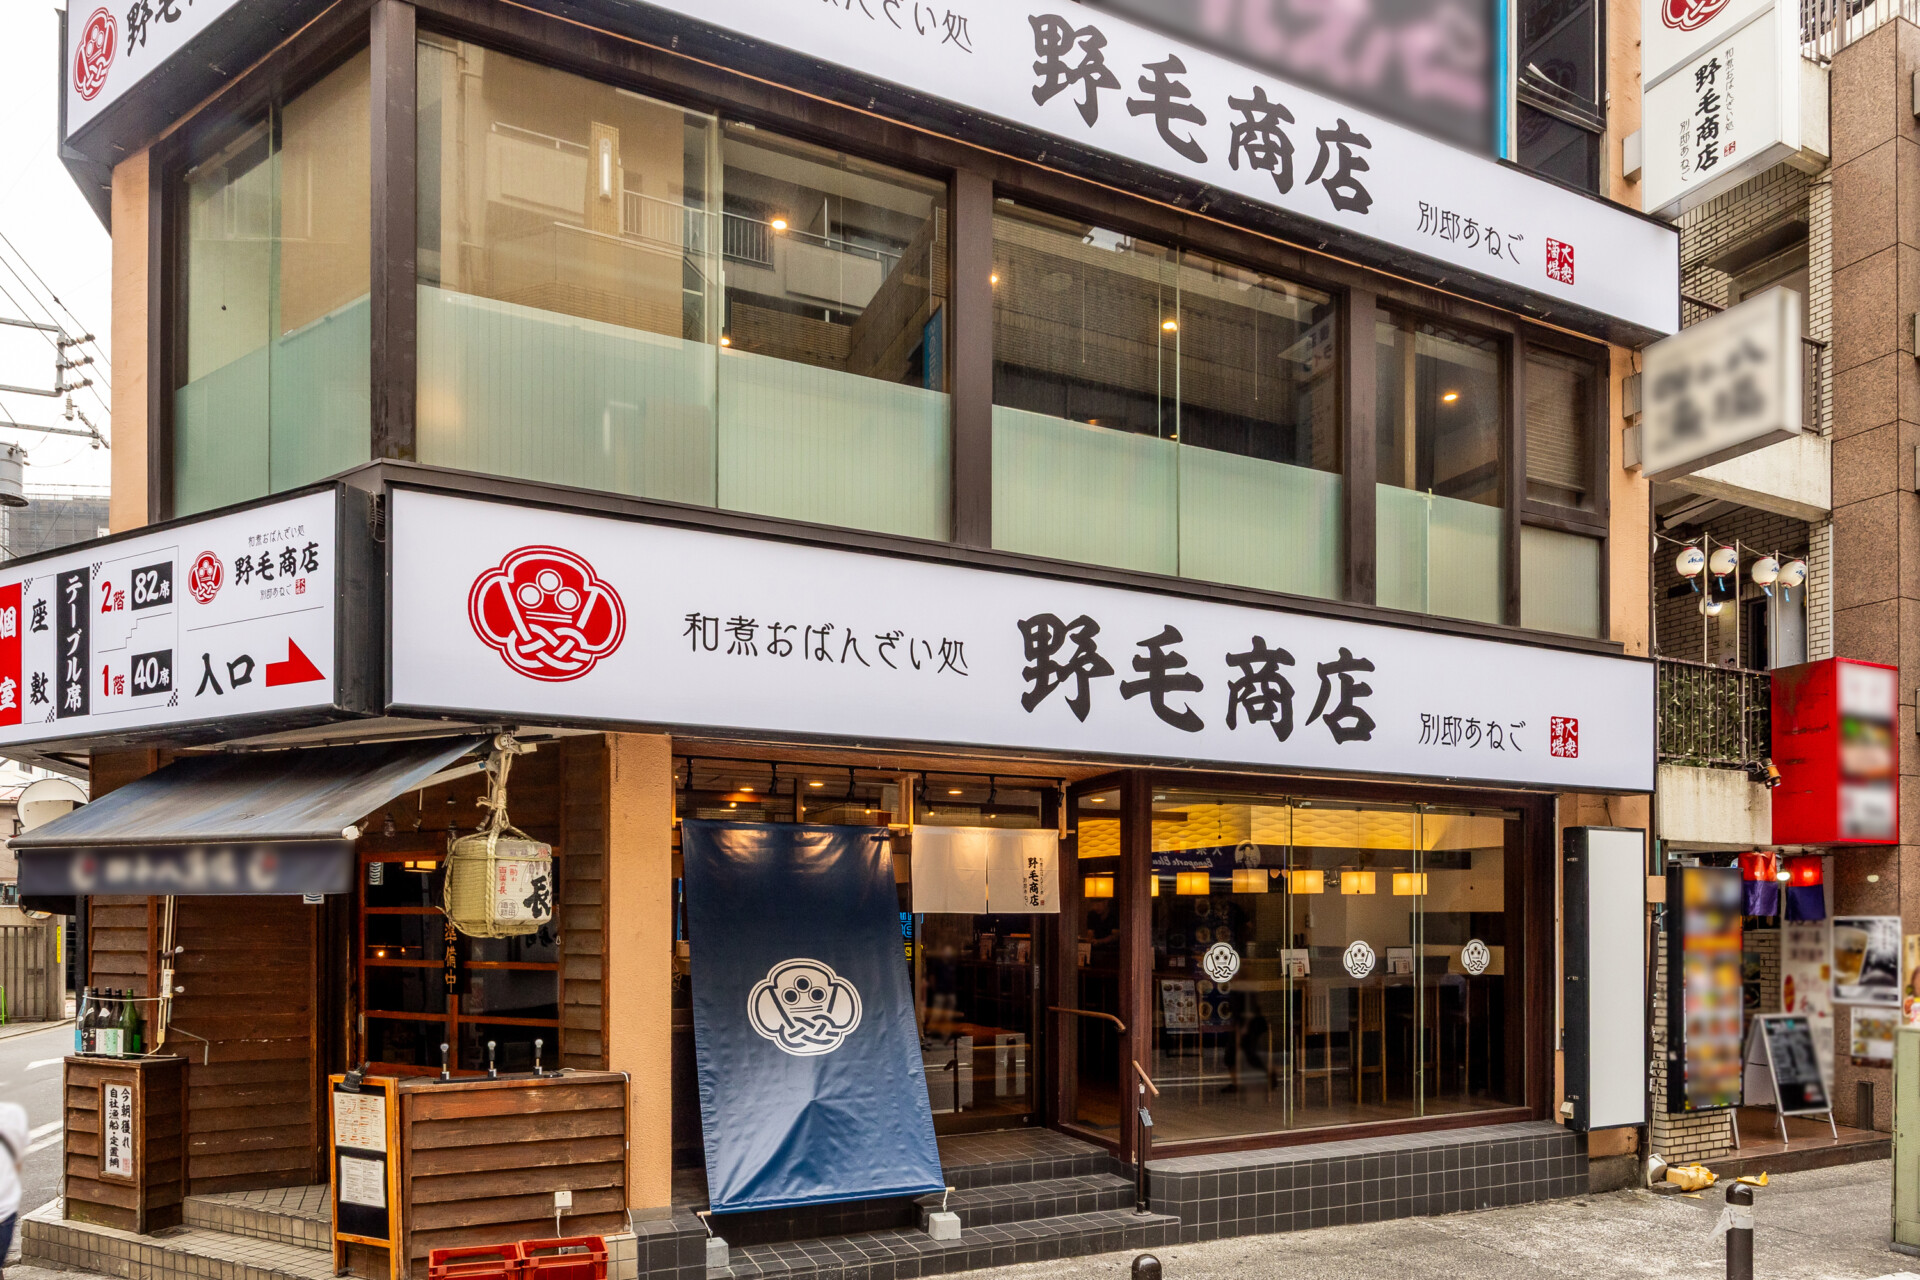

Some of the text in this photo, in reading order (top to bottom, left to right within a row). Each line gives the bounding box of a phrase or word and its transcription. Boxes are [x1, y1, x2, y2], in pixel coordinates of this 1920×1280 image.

[1028, 13, 1373, 214] 野毛商店
[1694, 57, 1722, 173] 野毛商店
[1417, 200, 1524, 265] 別邸あねご
[101, 570, 170, 614] 2階 82席
[235, 541, 319, 586] 野毛商店
[29, 598, 49, 706] 座敷
[64, 575, 83, 712] テーブル席
[195, 652, 255, 697] 入口
[683, 612, 968, 676] 和煮おばんざい処
[102, 657, 170, 697] 1階 40席
[1017, 613, 1376, 744] 野毛商店
[1419, 713, 1526, 752] 別邸あねご
[1028, 857, 1039, 906] 野毛商店
[445, 922, 457, 993] 準備中
